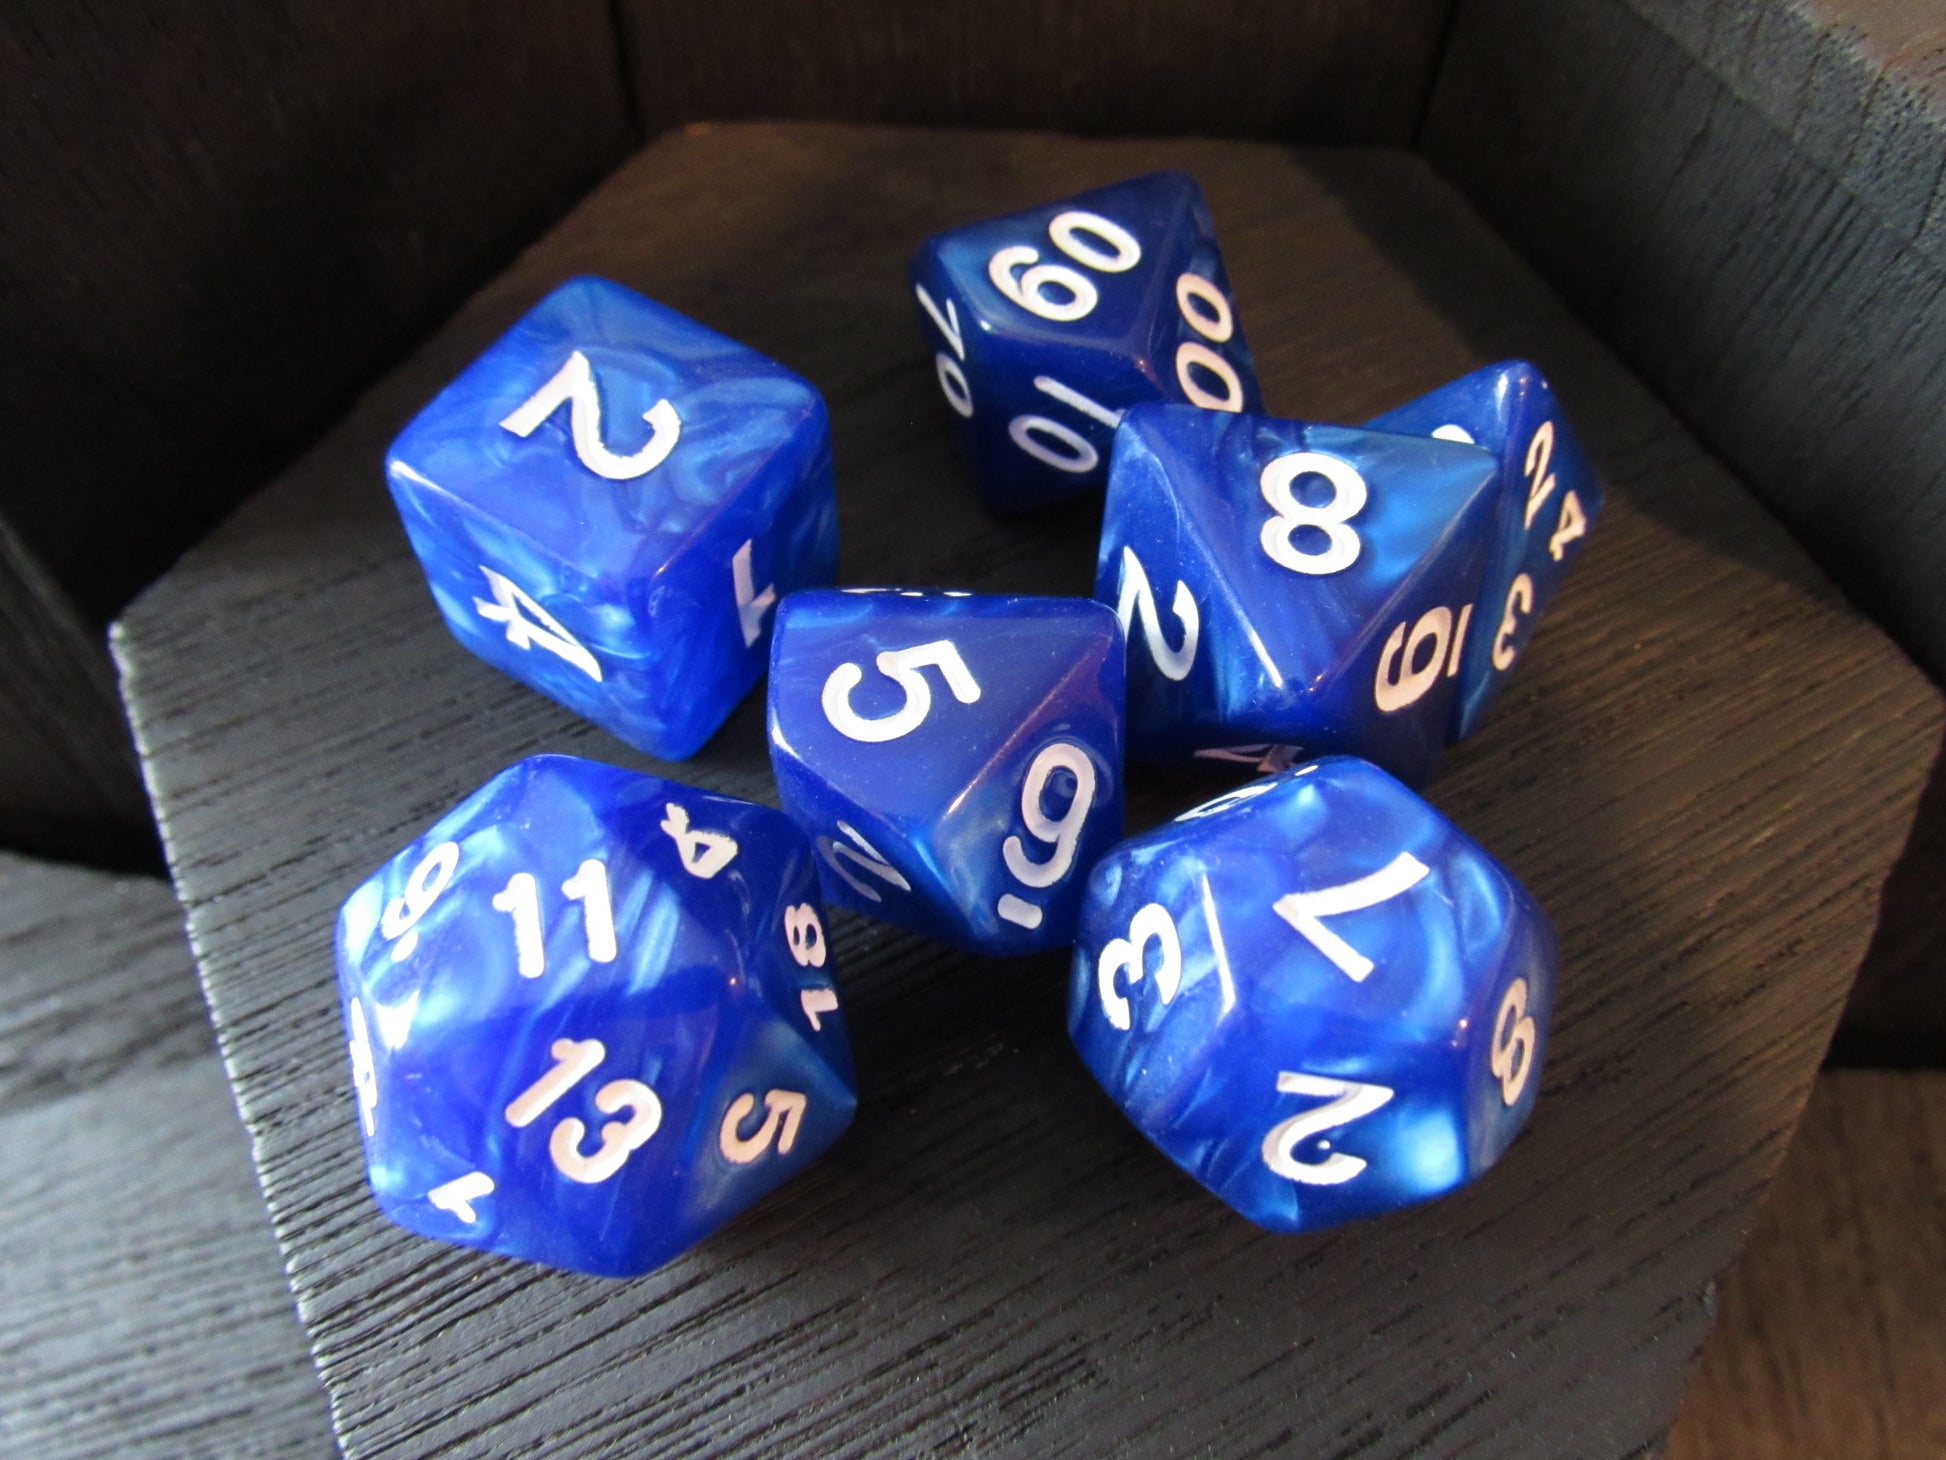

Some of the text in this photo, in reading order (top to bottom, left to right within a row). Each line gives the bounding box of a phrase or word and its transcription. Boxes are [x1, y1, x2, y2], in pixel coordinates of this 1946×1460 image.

[988, 211, 1141, 322] 60
[1175, 272, 1244, 413] 00
[499, 350, 682, 480] 2
[1523, 420, 1556, 530] 2
[1259, 451, 1368, 575] 8
[1550, 490, 1588, 562] 4
[473, 565, 604, 683] 4
[1113, 545, 1200, 681] 2
[1492, 573, 1533, 671] 3
[820, 639, 982, 743] 5
[659, 802, 739, 880] 4
[491, 857, 620, 979] 11
[1097, 902, 1183, 1031] 3
[1272, 851, 1432, 983] 7
[1490, 976, 1537, 1107] 8
[504, 1037, 663, 1184] 13
[719, 1088, 807, 1165] 5
[1261, 1071, 1395, 1186] 2
